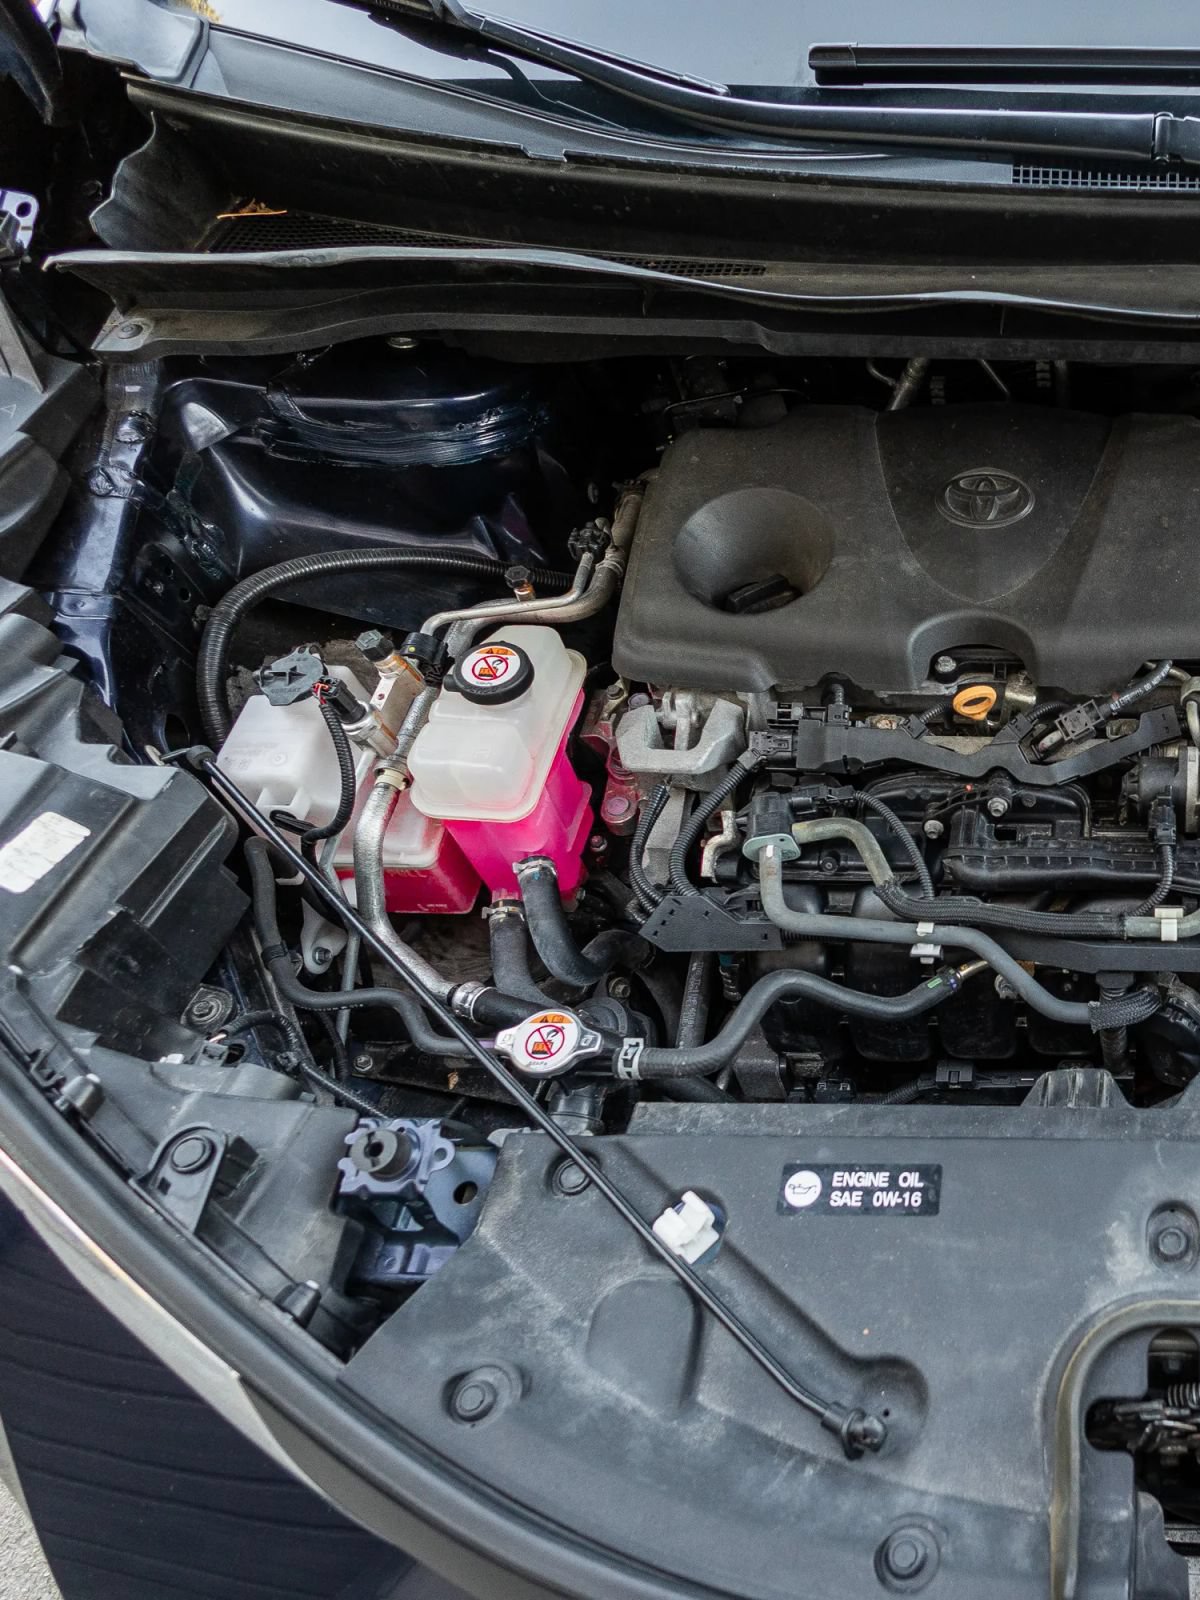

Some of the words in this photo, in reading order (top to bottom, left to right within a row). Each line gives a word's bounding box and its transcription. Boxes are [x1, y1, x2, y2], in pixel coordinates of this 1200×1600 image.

[832, 1171, 890, 1188] ENGINE
[898, 1171, 924, 1188] OIL
[829, 1190, 863, 1207] SAE
[872, 1191, 922, 1207] 0W-16
